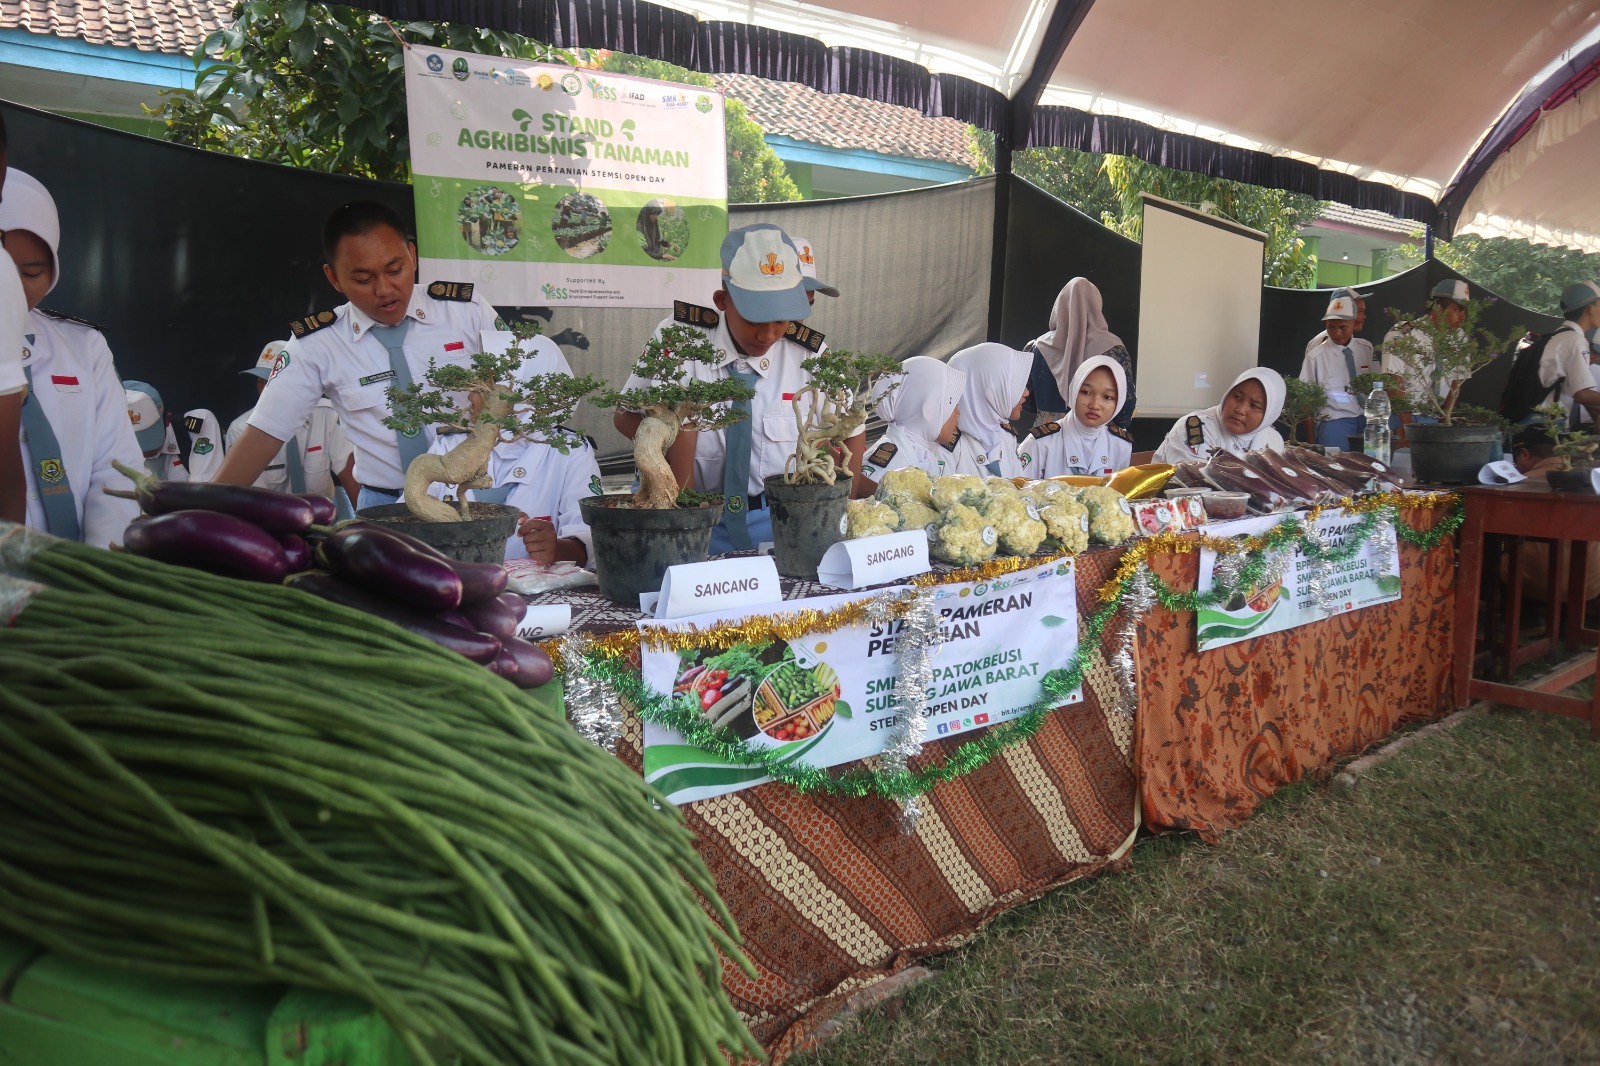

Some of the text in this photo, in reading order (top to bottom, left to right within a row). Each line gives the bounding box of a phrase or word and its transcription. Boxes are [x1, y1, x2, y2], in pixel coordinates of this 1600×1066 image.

[541, 112, 614, 138] STAND
[457, 127, 690, 169] AGRIBISNIS TANAMAN
[486, 161, 666, 184] PAMERAN PERTANIAN STEMSI OPEN DAY
[866, 544, 915, 566] SANCANG
[694, 577, 759, 598] SANCANG
[940, 592, 1033, 623] PAMERAN
[932, 648, 1023, 684] PATOKBEUSI
[938, 675, 983, 697] JAWA
[985, 662, 1040, 685] BARAT
[961, 692, 989, 712] DAY
